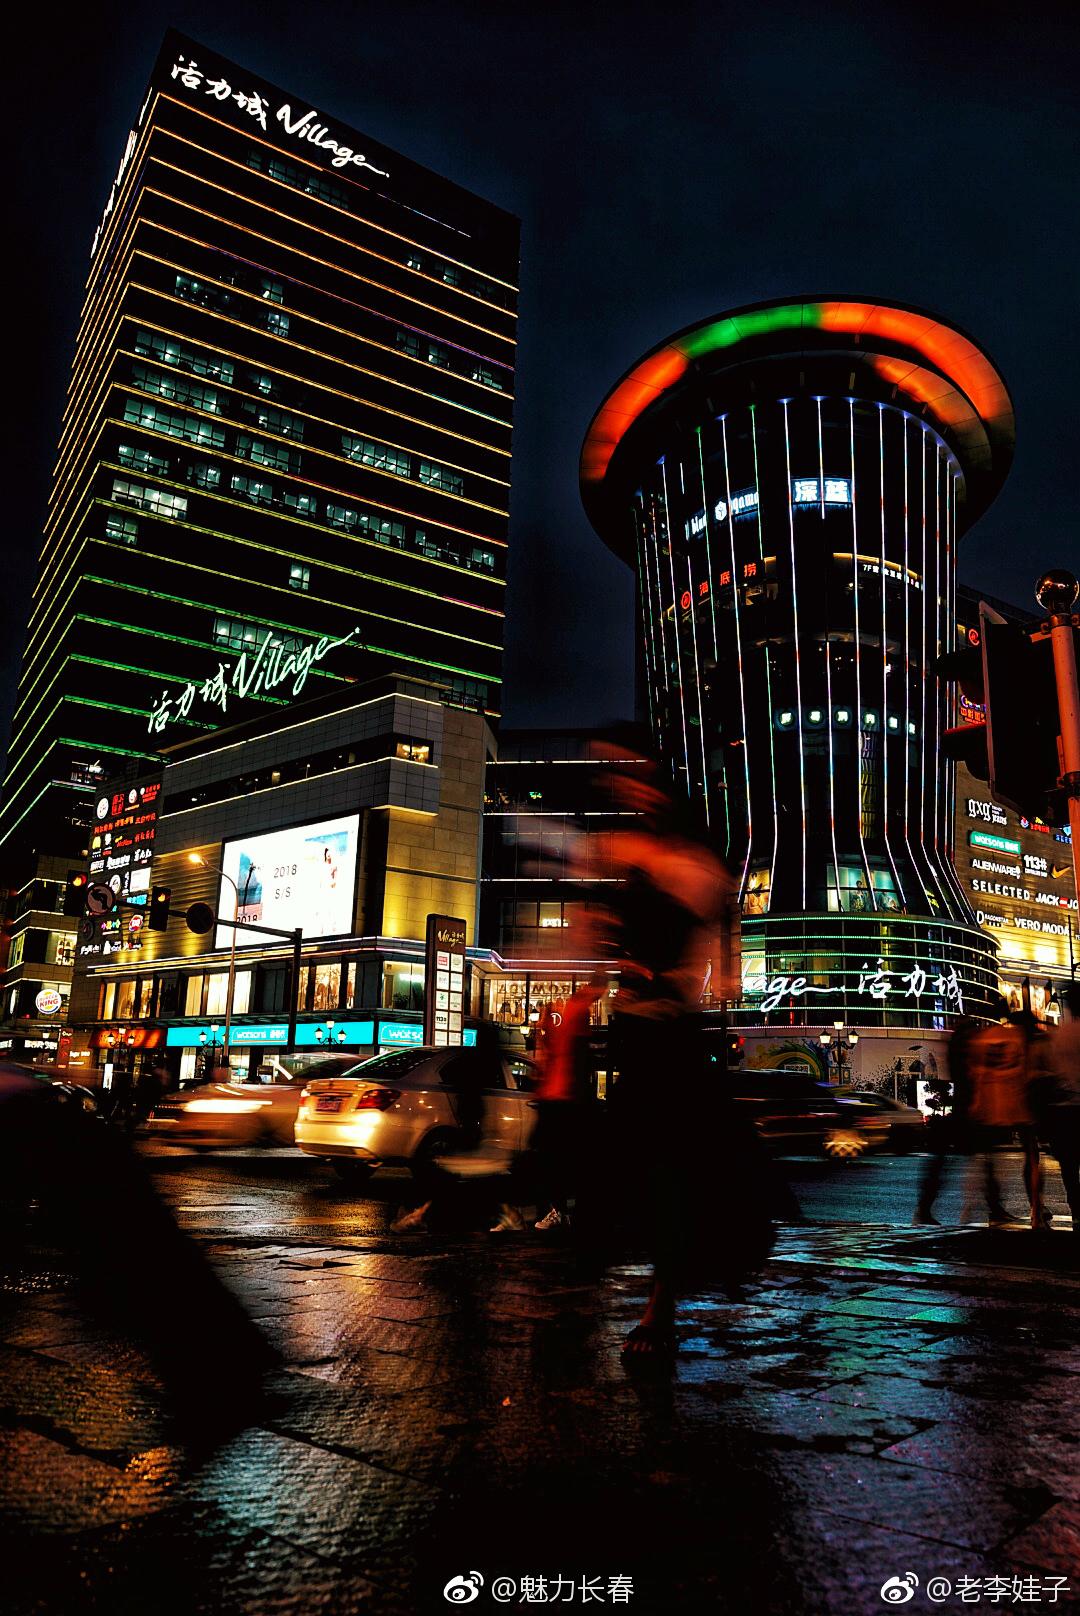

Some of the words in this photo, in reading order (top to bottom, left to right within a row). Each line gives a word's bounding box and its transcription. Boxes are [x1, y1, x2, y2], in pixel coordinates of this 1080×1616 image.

[171, 54, 269, 131] 活力城
[276, 104, 390, 178] Village
[232, 627, 360, 697] Village
[148, 663, 231, 733] 活力城
[968, 799, 991, 822] gxg
[274, 864, 297, 878] 2018
[972, 858, 1016, 877] ALIENWARE
[972, 879, 1031, 900] SELECTED
[1035, 892, 1060, 907] JACK
[1014, 917, 1041, 932] VERO
[1042, 922, 1070, 937] MODA
[858, 958, 964, 1015] 活力城
[39, 999, 59, 1008] KING
